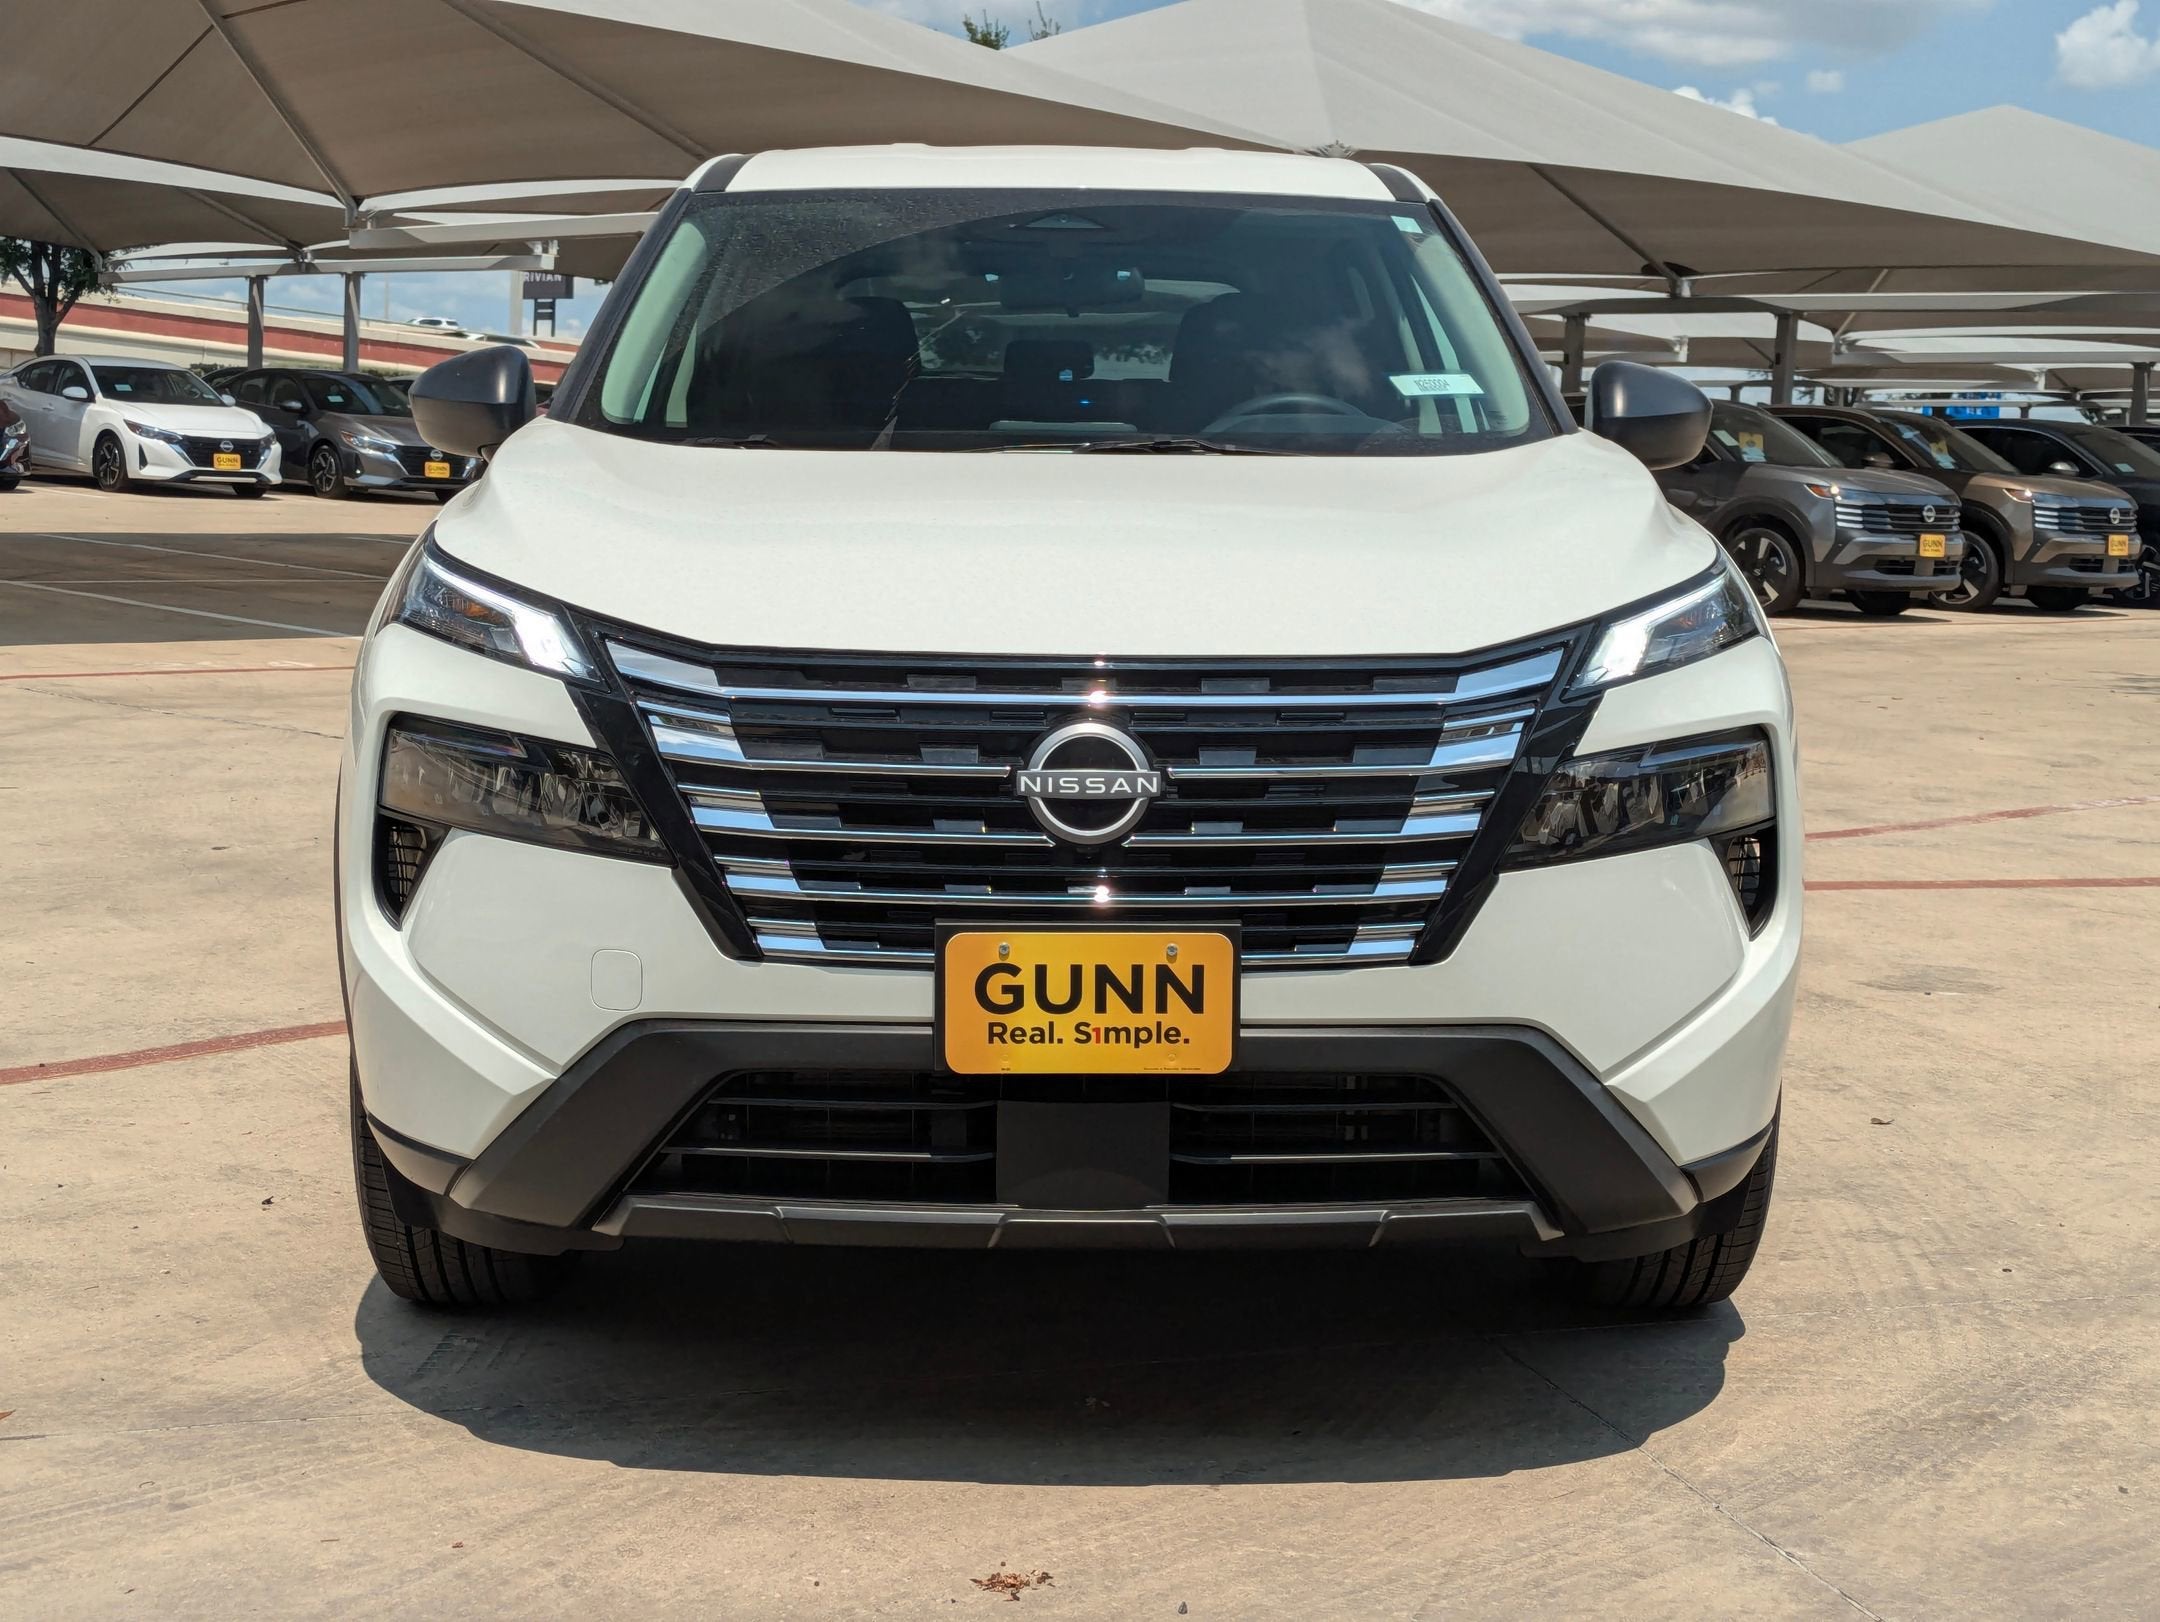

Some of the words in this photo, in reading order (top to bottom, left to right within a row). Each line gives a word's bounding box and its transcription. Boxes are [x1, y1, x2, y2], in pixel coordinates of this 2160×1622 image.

[524, 272, 562, 282] RIVIAN
[1020, 776, 1157, 794] NISSAN
[974, 962, 1205, 1015] GUNN
[987, 1021, 1063, 1045] Real.
